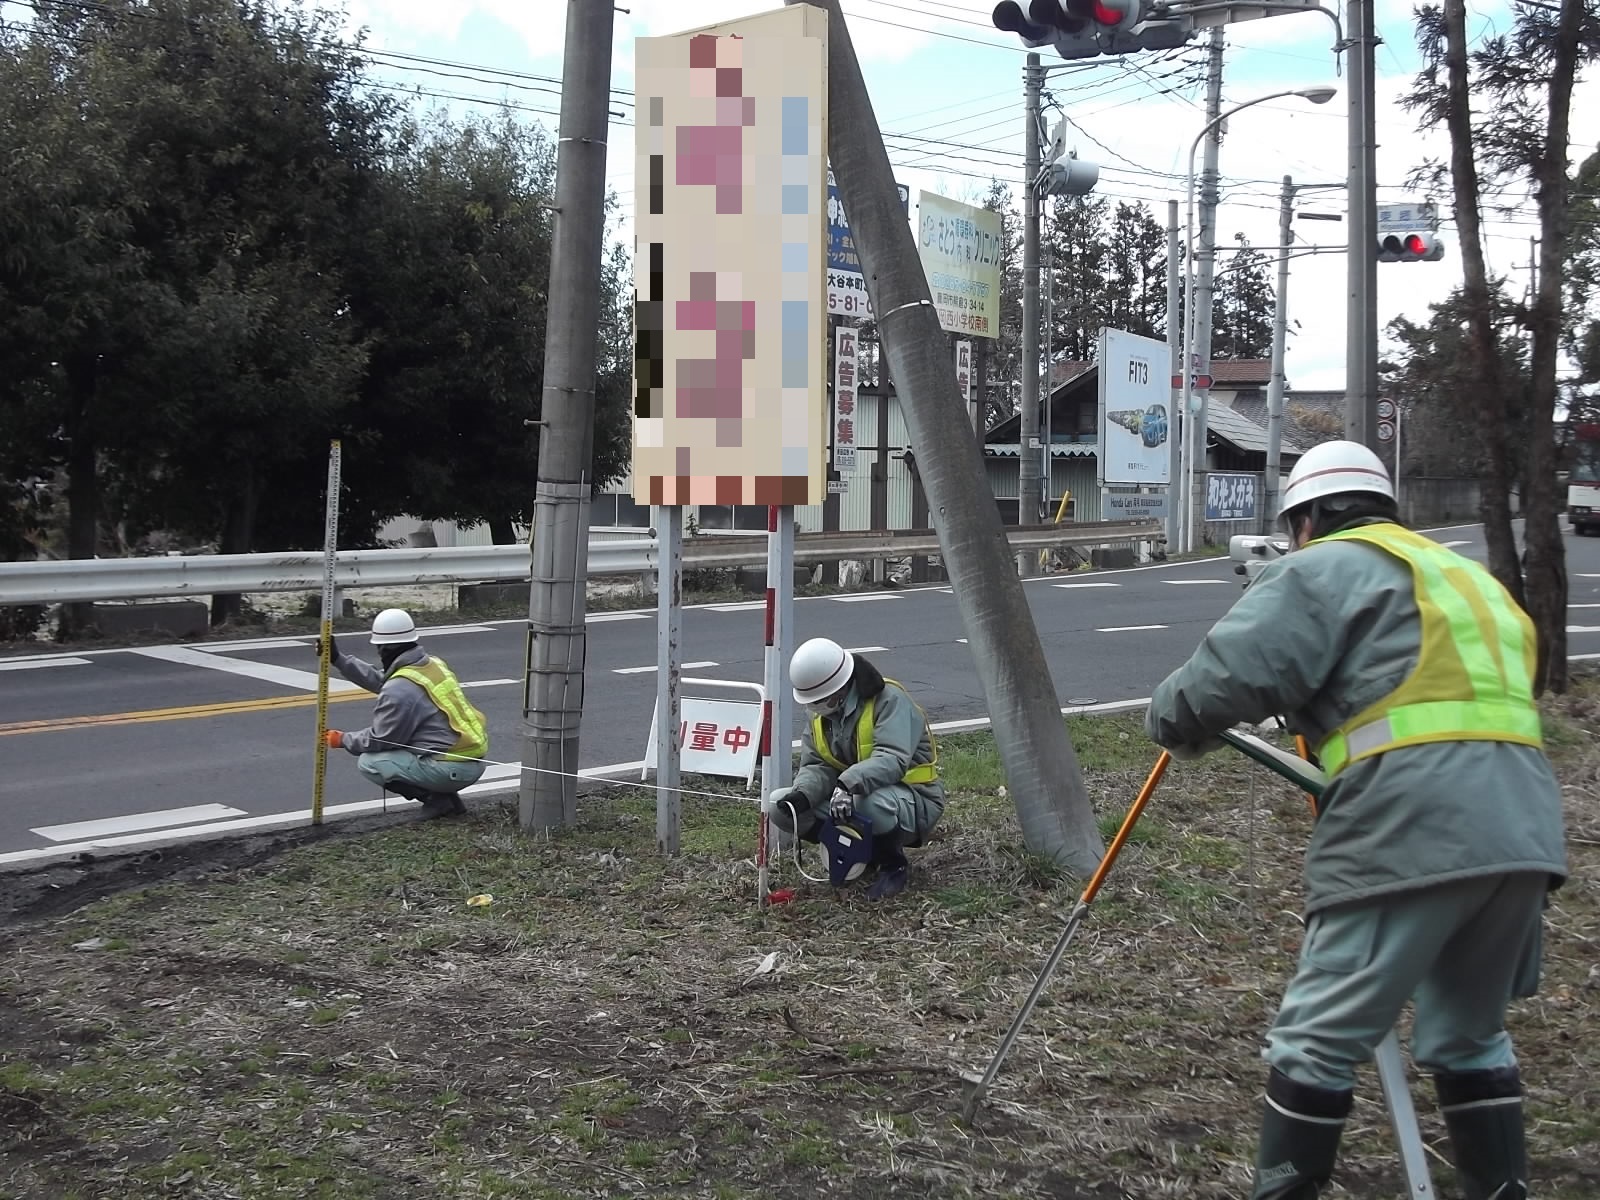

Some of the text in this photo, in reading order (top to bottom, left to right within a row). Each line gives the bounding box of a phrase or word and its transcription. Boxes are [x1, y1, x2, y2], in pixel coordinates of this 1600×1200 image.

[827, 273, 867, 292] 大谷本町
[837, 332, 855, 445] 広告募集
[1128, 361, 1148, 385] FIT3
[1208, 476, 1254, 510] 和光メガネ
[680, 721, 751, 754] 量中
